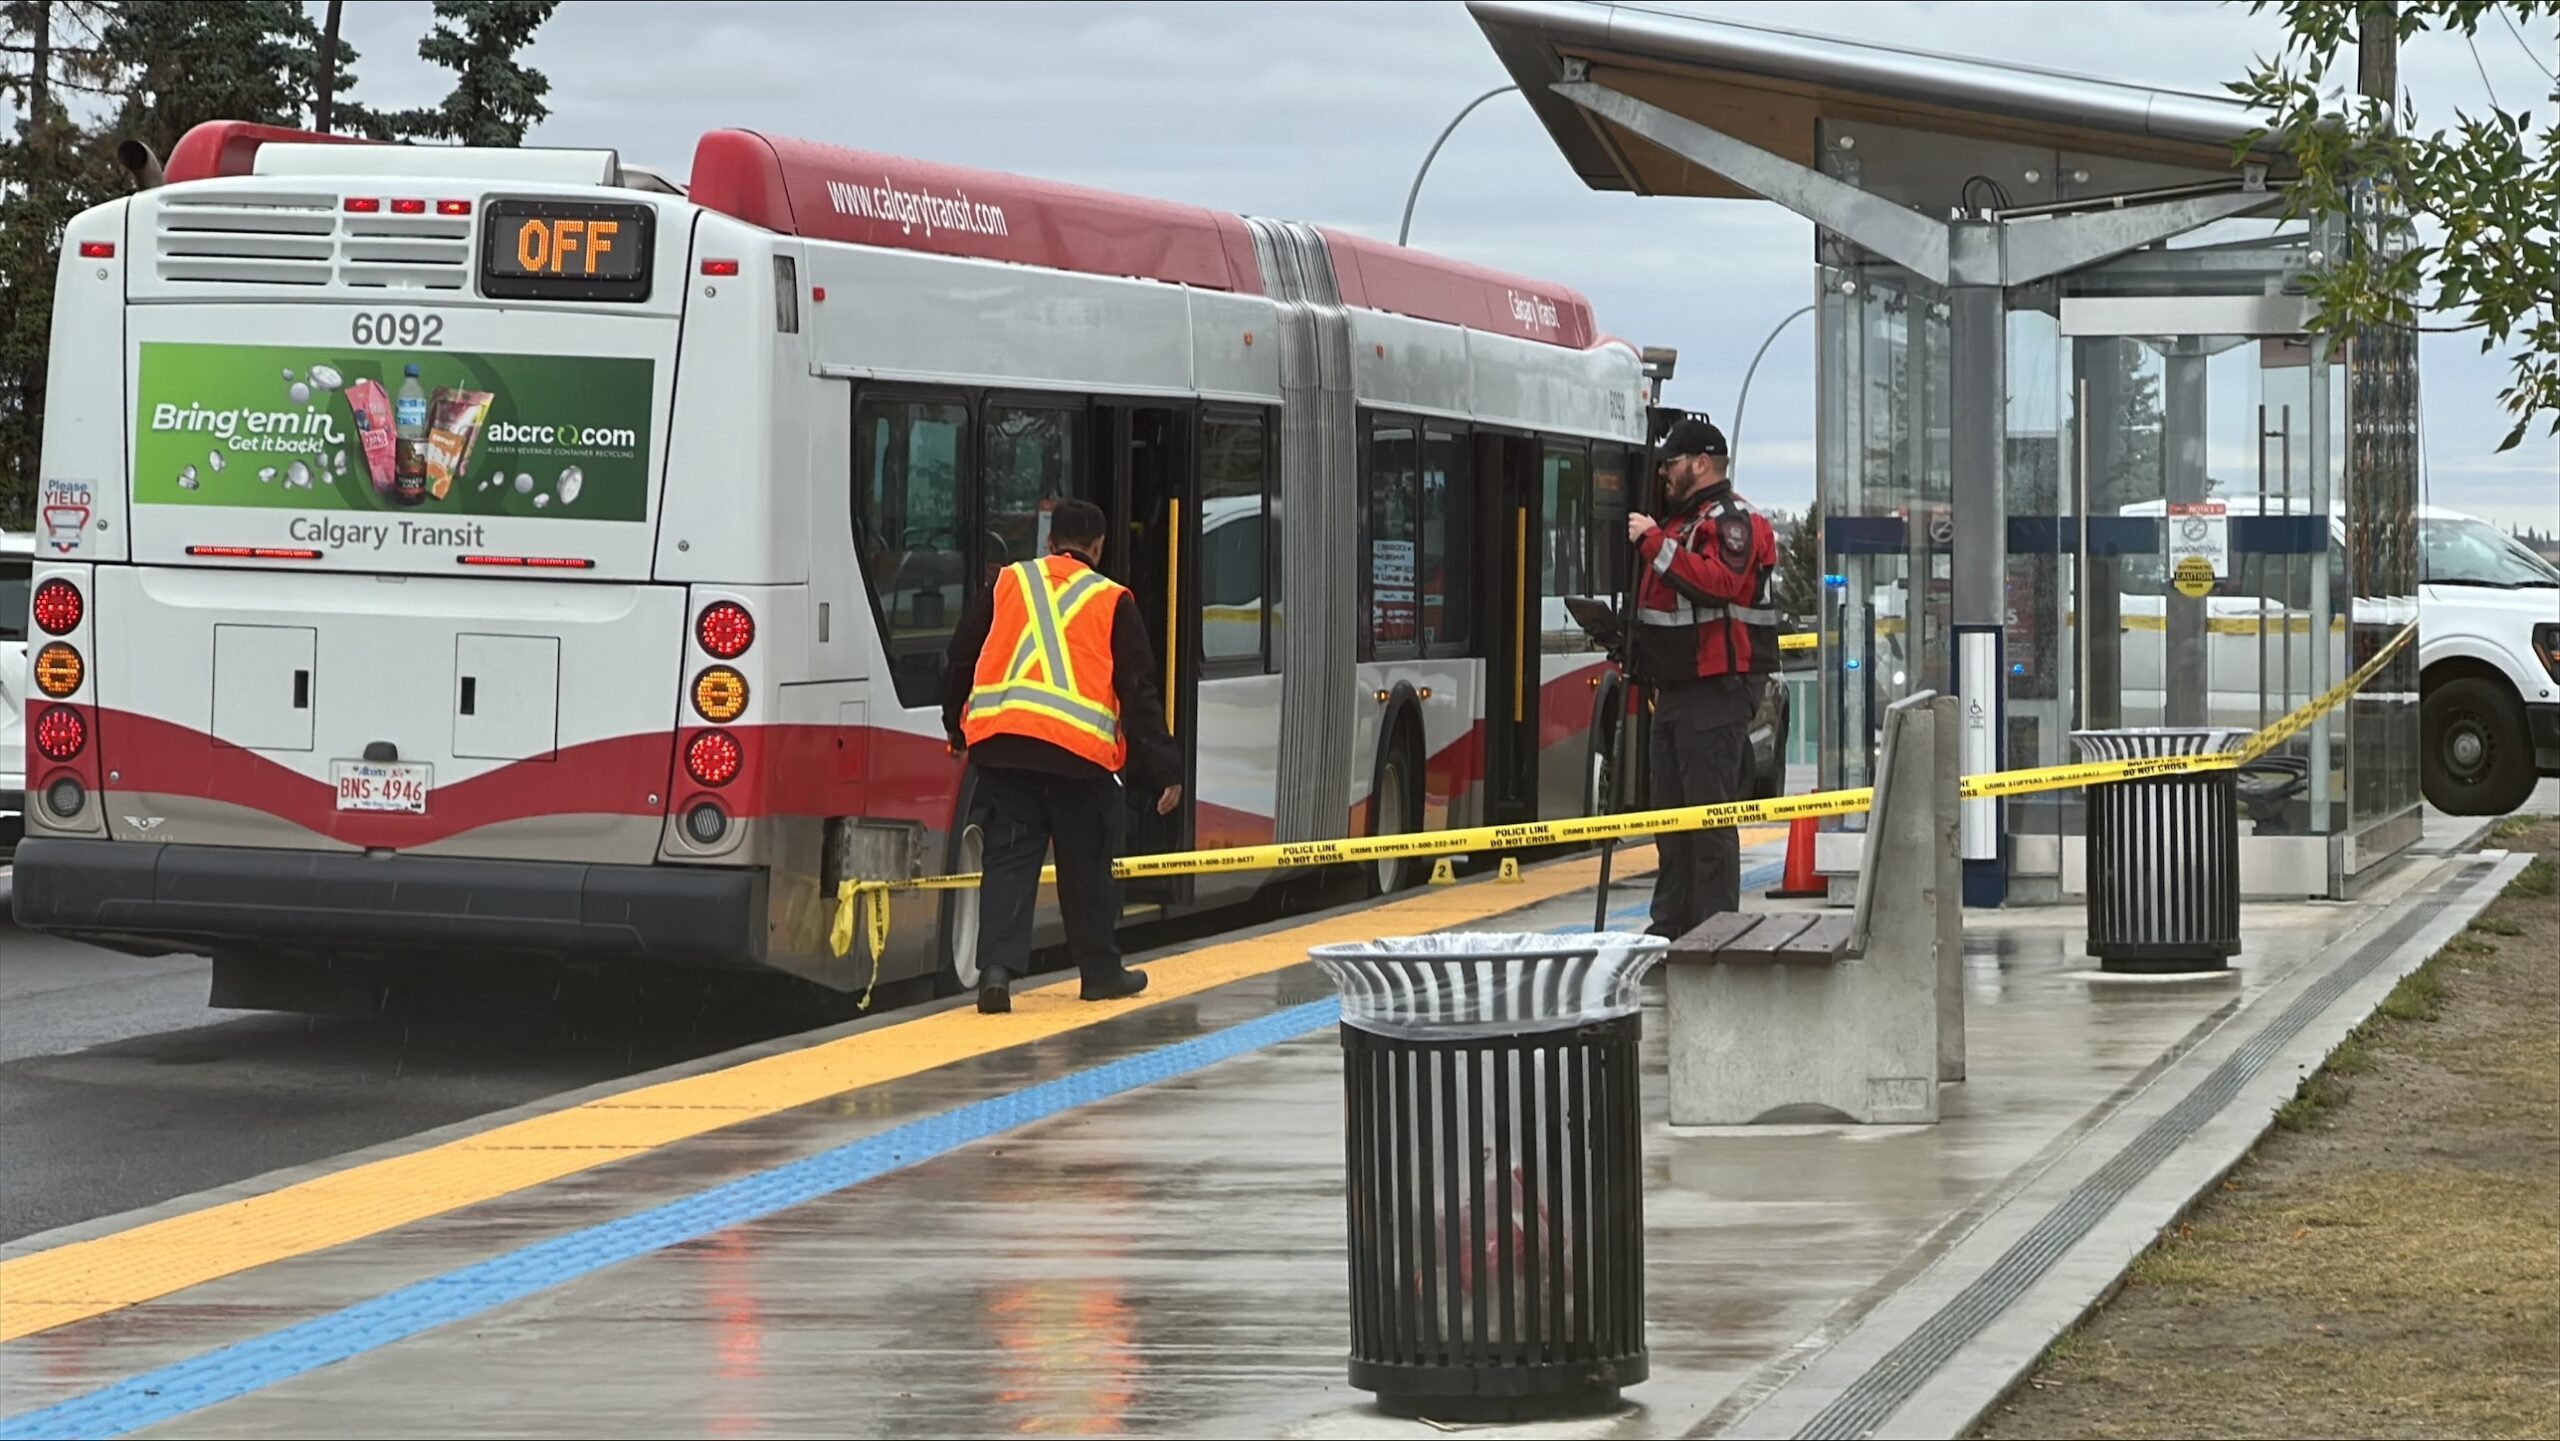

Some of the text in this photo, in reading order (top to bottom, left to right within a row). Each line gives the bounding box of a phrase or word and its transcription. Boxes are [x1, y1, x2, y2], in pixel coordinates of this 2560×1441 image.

[826, 176, 1008, 238] www.calgarytransit.com
[518, 219, 618, 273] OFF
[1508, 289, 1538, 332] Calgary
[352, 313, 443, 346] 6092
[152, 401, 239, 438] Bring
[303, 405, 338, 440] in
[228, 436, 259, 450] Get
[261, 436, 274, 451] it
[517, 447, 552, 455] BEVERAGE
[554, 449, 593, 457] CONTAINER
[595, 450, 634, 458] RECYCLING
[49, 479, 88, 491] Please
[45, 491, 91, 505] YIELD
[289, 517, 485, 550] Calgary Transit
[2176, 571, 2213, 581] CAUTION
[2138, 765, 2155, 774] NOT
[2158, 761, 2188, 772] CROSS
[341, 777, 422, 801] BNS-4946
[1707, 803, 1760, 816] POLICE LINE
[1774, 805, 1795, 814] CRIME
[1798, 802, 1832, 812] STOPPERS
[1717, 816, 1734, 825] NOT
[1737, 813, 1767, 823] CROSS
[1495, 824, 1549, 837] POLICE LINE
[1562, 827, 1584, 836] CRIME
[1587, 823, 1621, 834] STOPPERS
[1490, 834, 1556, 848] DO NOT CROSS
[1283, 843, 1336, 855] POLICE LINE
[1350, 847, 1372, 855] CRIME
[1374, 844, 1409, 852] STOPPERS
[1138, 862, 1160, 870] CRIME
[1162, 859, 1196, 869] STOPPERS
[1278, 853, 1343, 865] DO NOT CROSS
[1437, 864, 1446, 878] 2
[1504, 863, 1513, 877] 3
